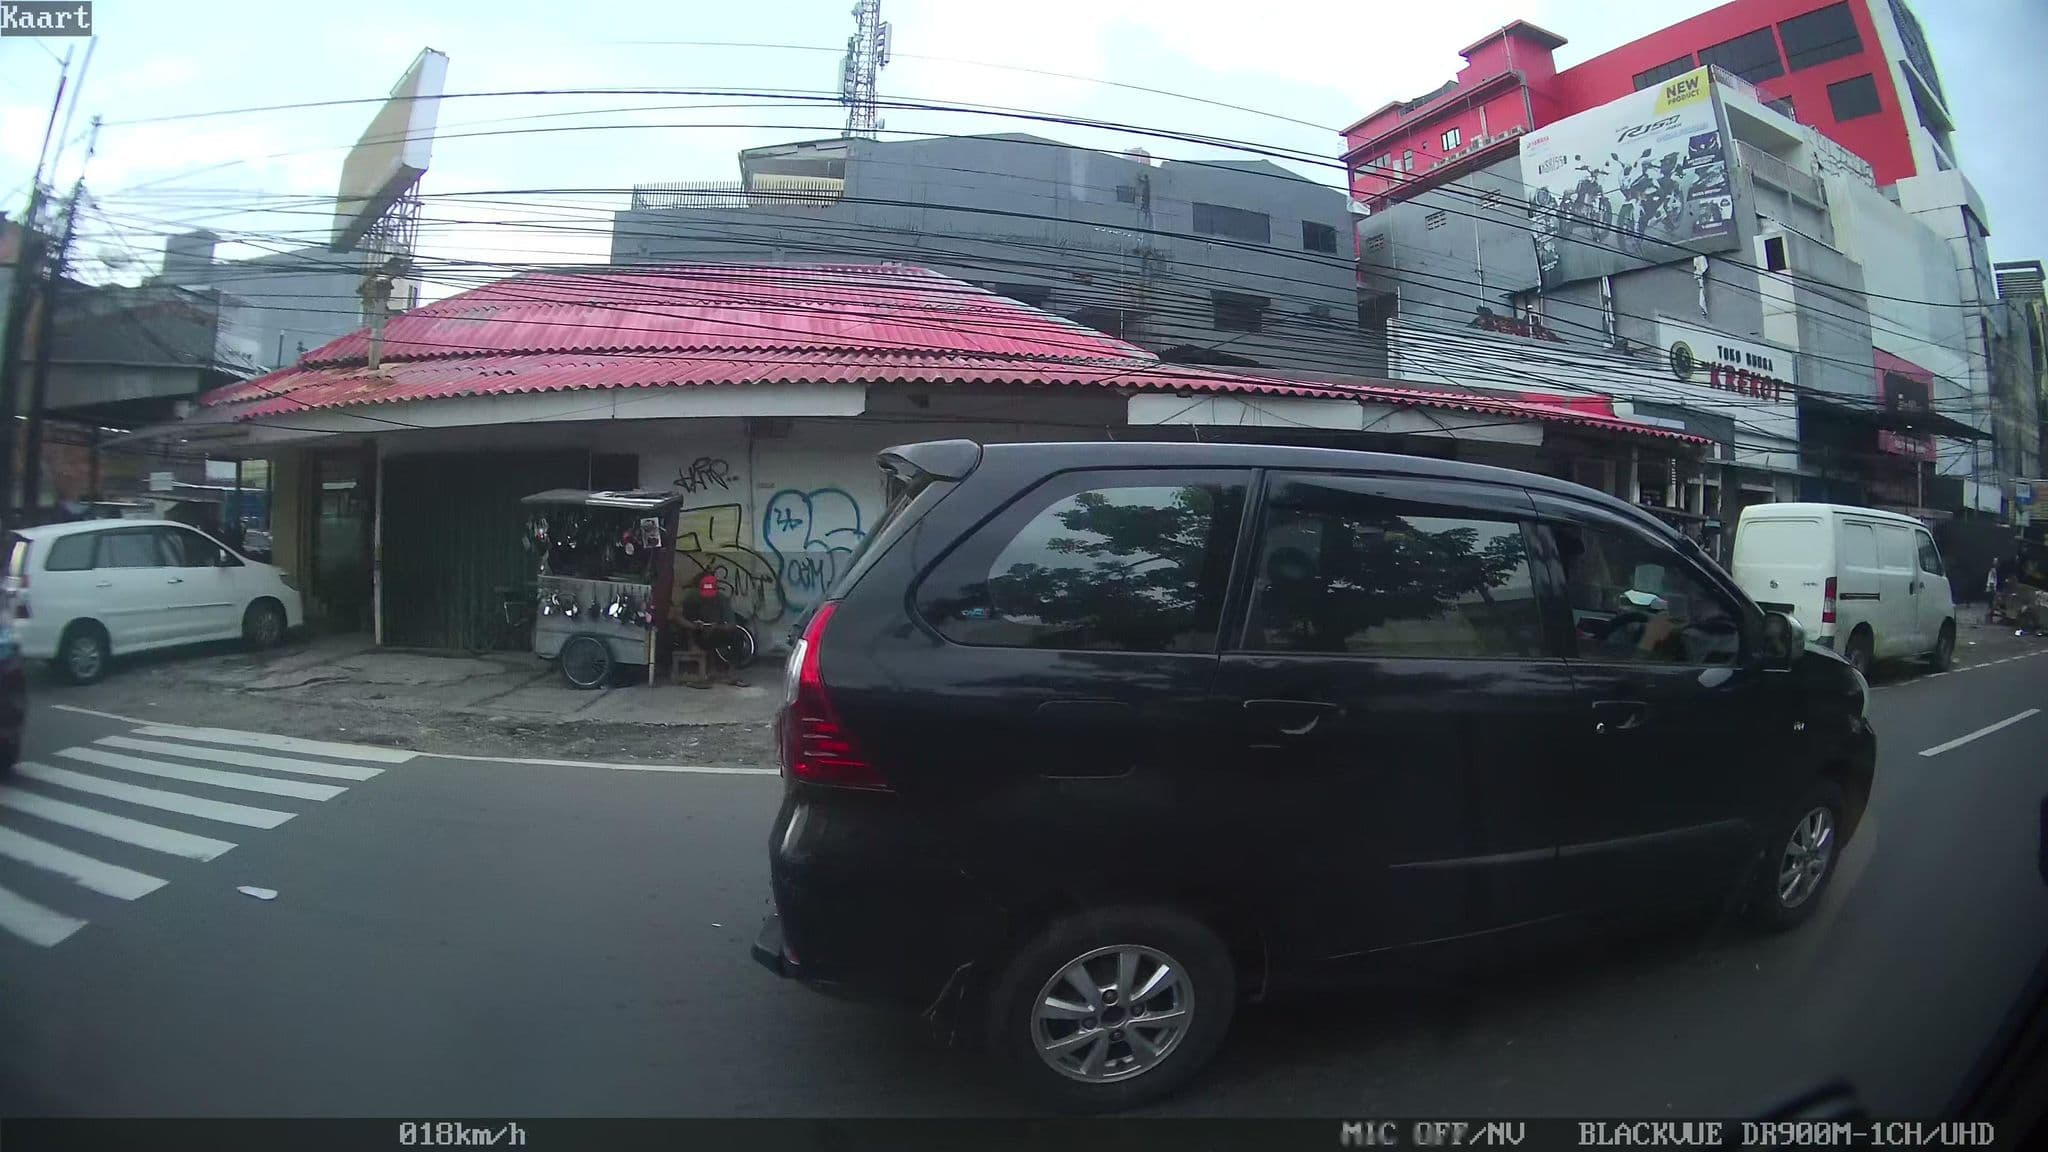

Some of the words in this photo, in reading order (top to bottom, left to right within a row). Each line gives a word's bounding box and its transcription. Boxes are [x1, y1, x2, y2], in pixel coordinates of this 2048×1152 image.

[1666, 76, 1699, 99] NEW
[1667, 89, 1700, 106] PRODUCT
[1717, 345, 1741, 363] TOKO
[1746, 353, 1773, 372] BUNGA
